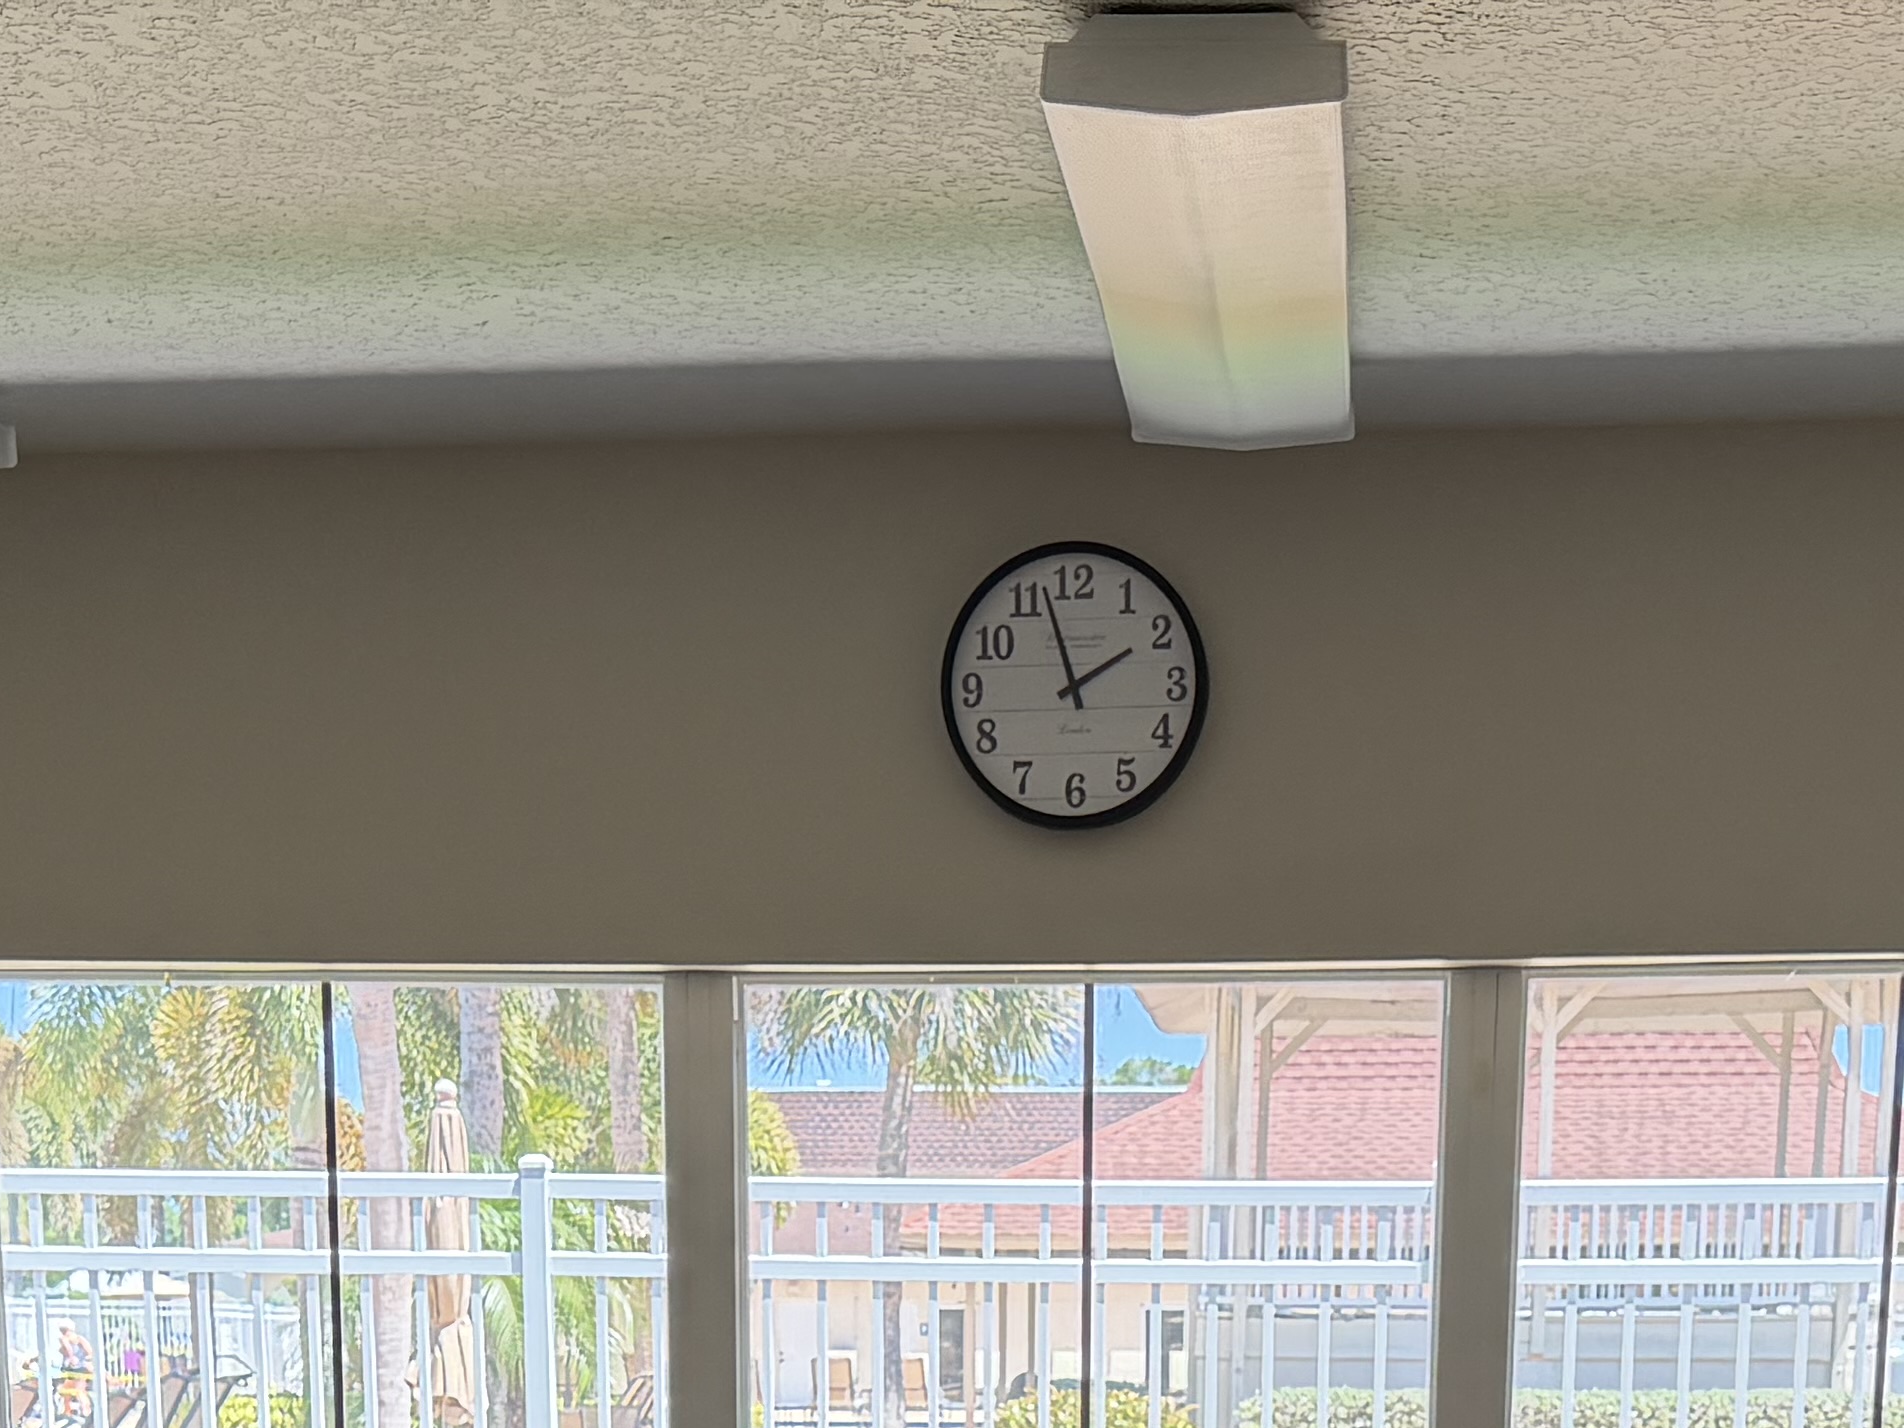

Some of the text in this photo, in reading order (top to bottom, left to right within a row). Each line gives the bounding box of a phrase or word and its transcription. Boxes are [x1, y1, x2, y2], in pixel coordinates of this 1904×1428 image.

[1008, 581, 1042, 617] 11
[1053, 564, 1094, 600] 12
[1118, 578, 1136, 614] 1
[975, 624, 1014, 660] 10
[1151, 614, 1172, 649] 2
[961, 672, 983, 708] 9
[1166, 666, 1188, 702] 3
[976, 718, 997, 754] 8
[1151, 713, 1173, 748] 4
[1012, 760, 1033, 795] 7
[1064, 772, 1086, 808] 6
[1115, 757, 1137, 792] 5
